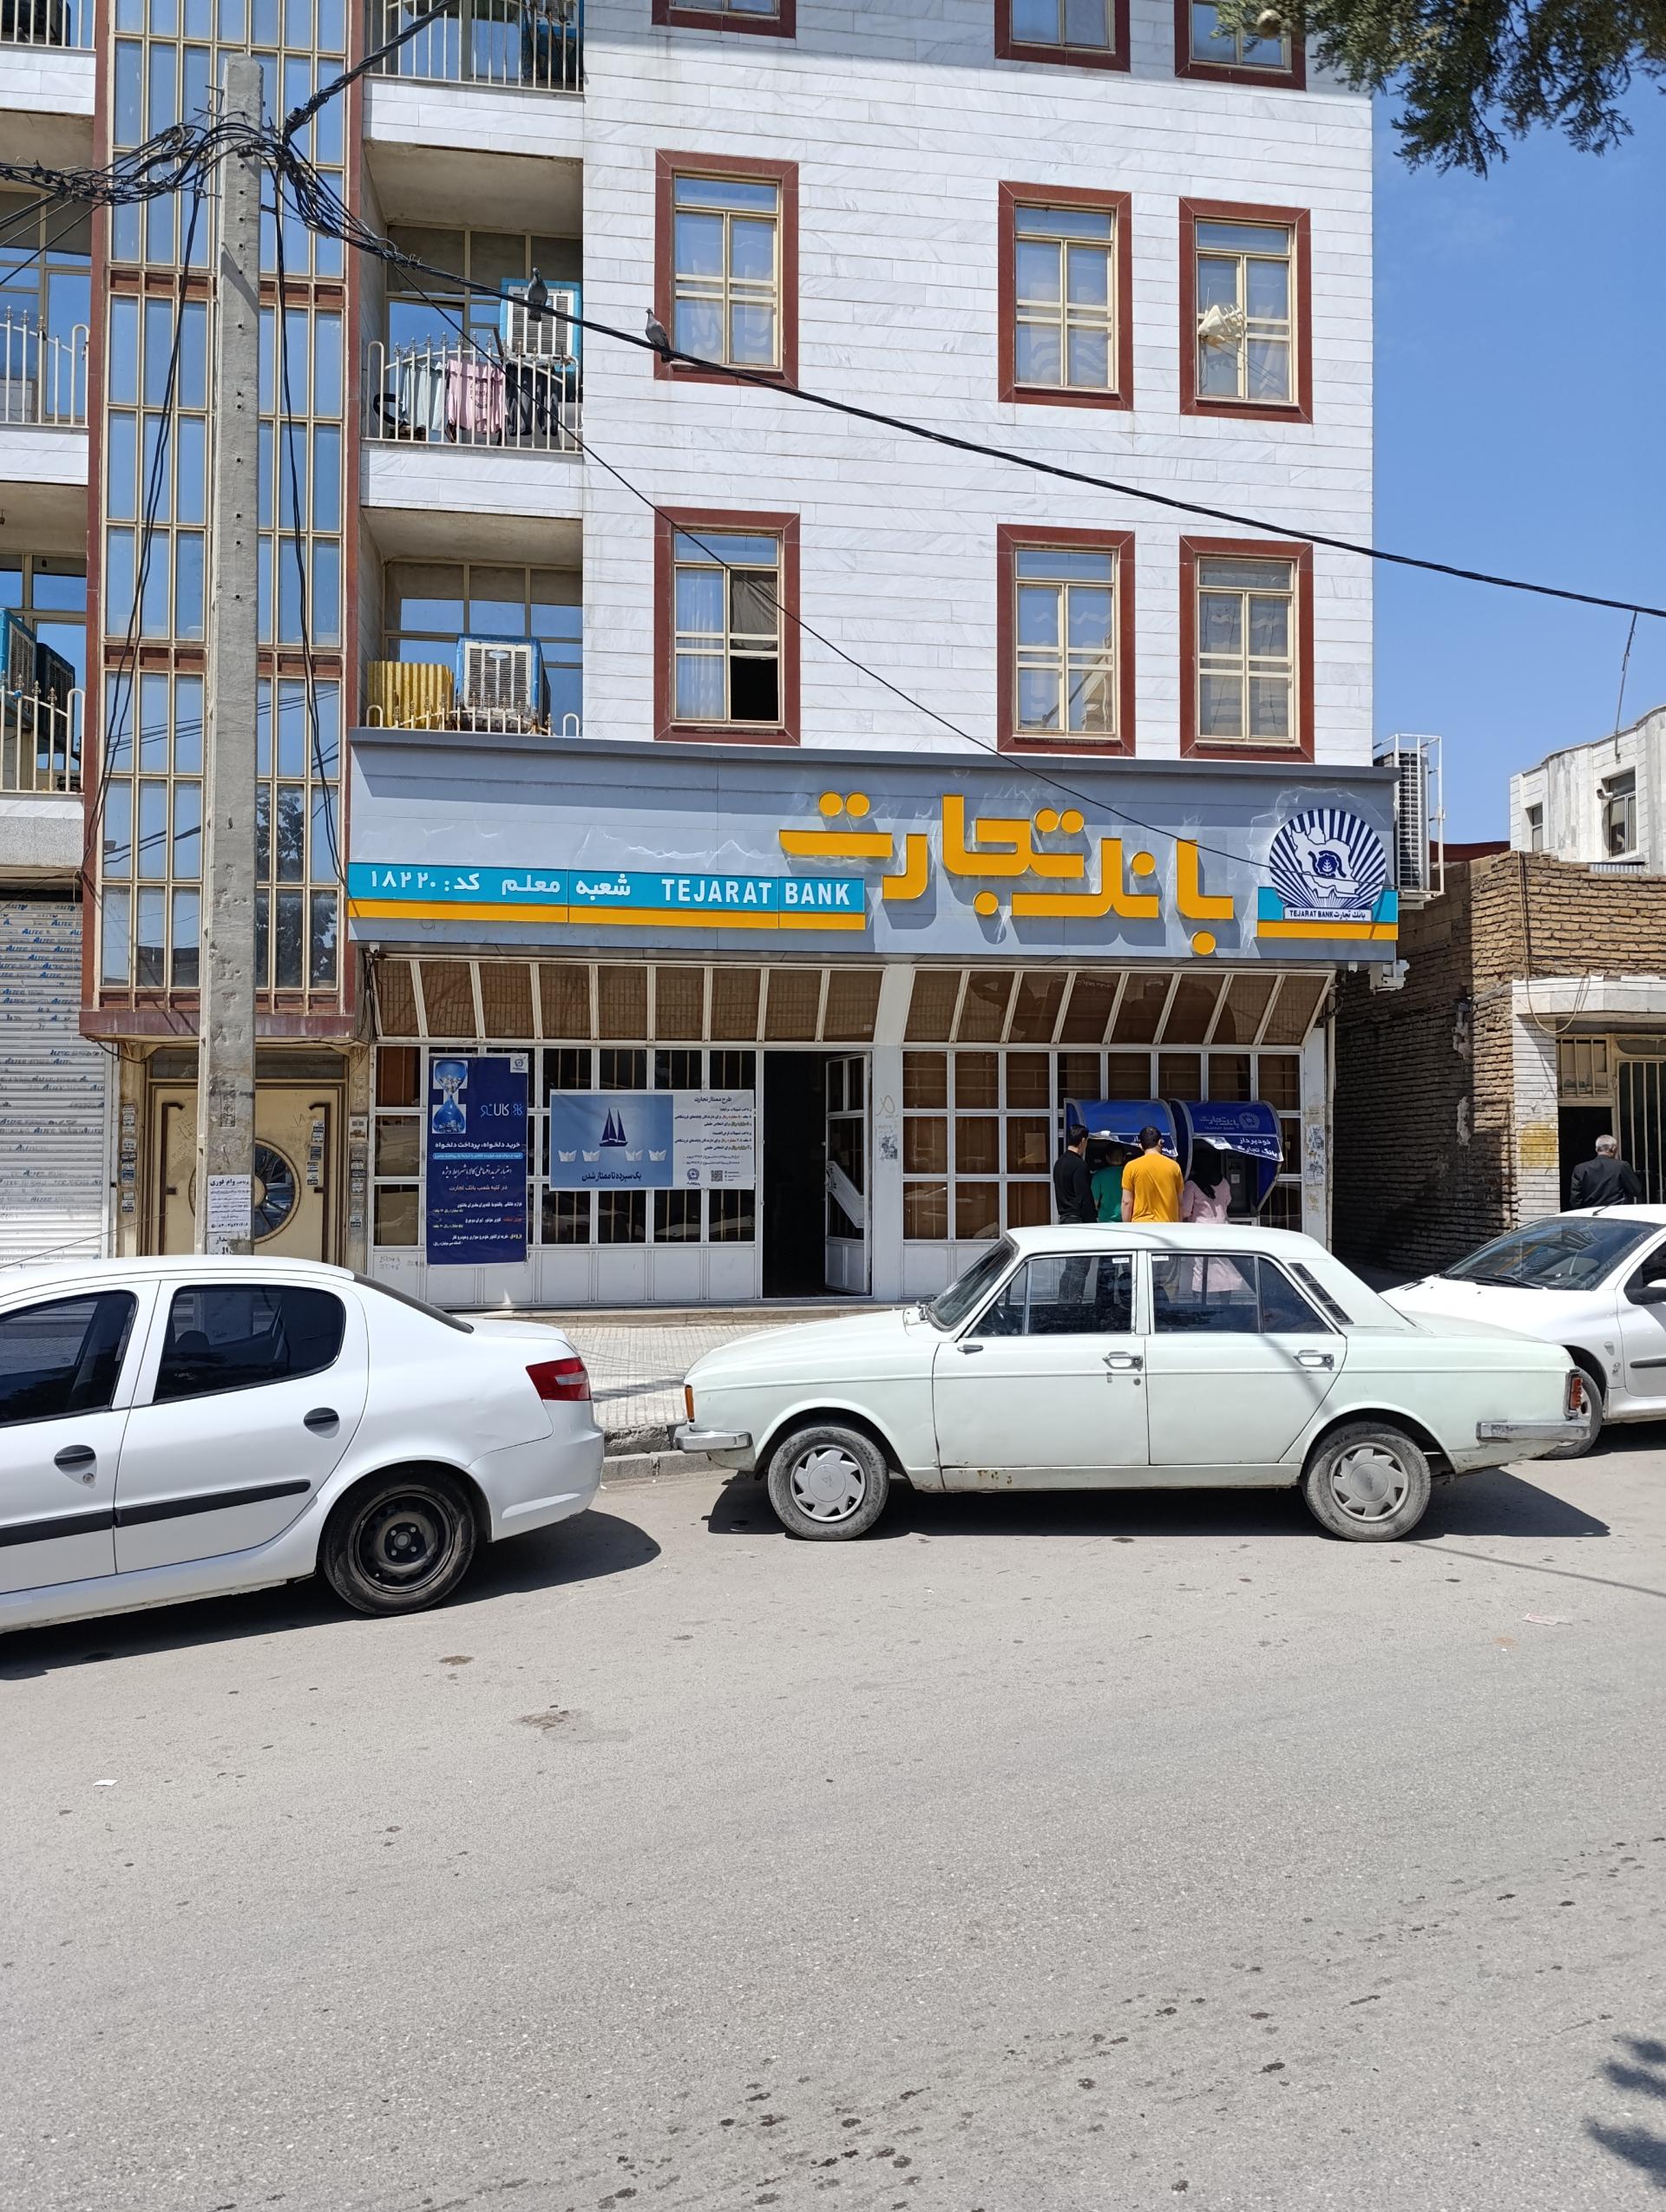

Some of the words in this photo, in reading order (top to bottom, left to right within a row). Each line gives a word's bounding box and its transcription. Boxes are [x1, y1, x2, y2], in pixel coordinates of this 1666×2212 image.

[779, 790, 1085, 916] تجارت
[444, 873, 480, 892] کد:
[502, 874, 561, 895] معلم
[575, 873, 631, 900] شعبه
[661, 877, 771, 905] TEJARAT
[785, 883, 850, 906] BANK
[1012, 837, 1234, 955] بانک
[1334, 909, 1351, 920] تجارت
[1352, 910, 1366, 920] بانک
[457, 1142, 480, 1150] پرداخت
[1239, 1137, 1271, 1146] خودپرداز
[1261, 1149, 1277, 1158] بانک
[581, 1171, 596, 1182] شدن
